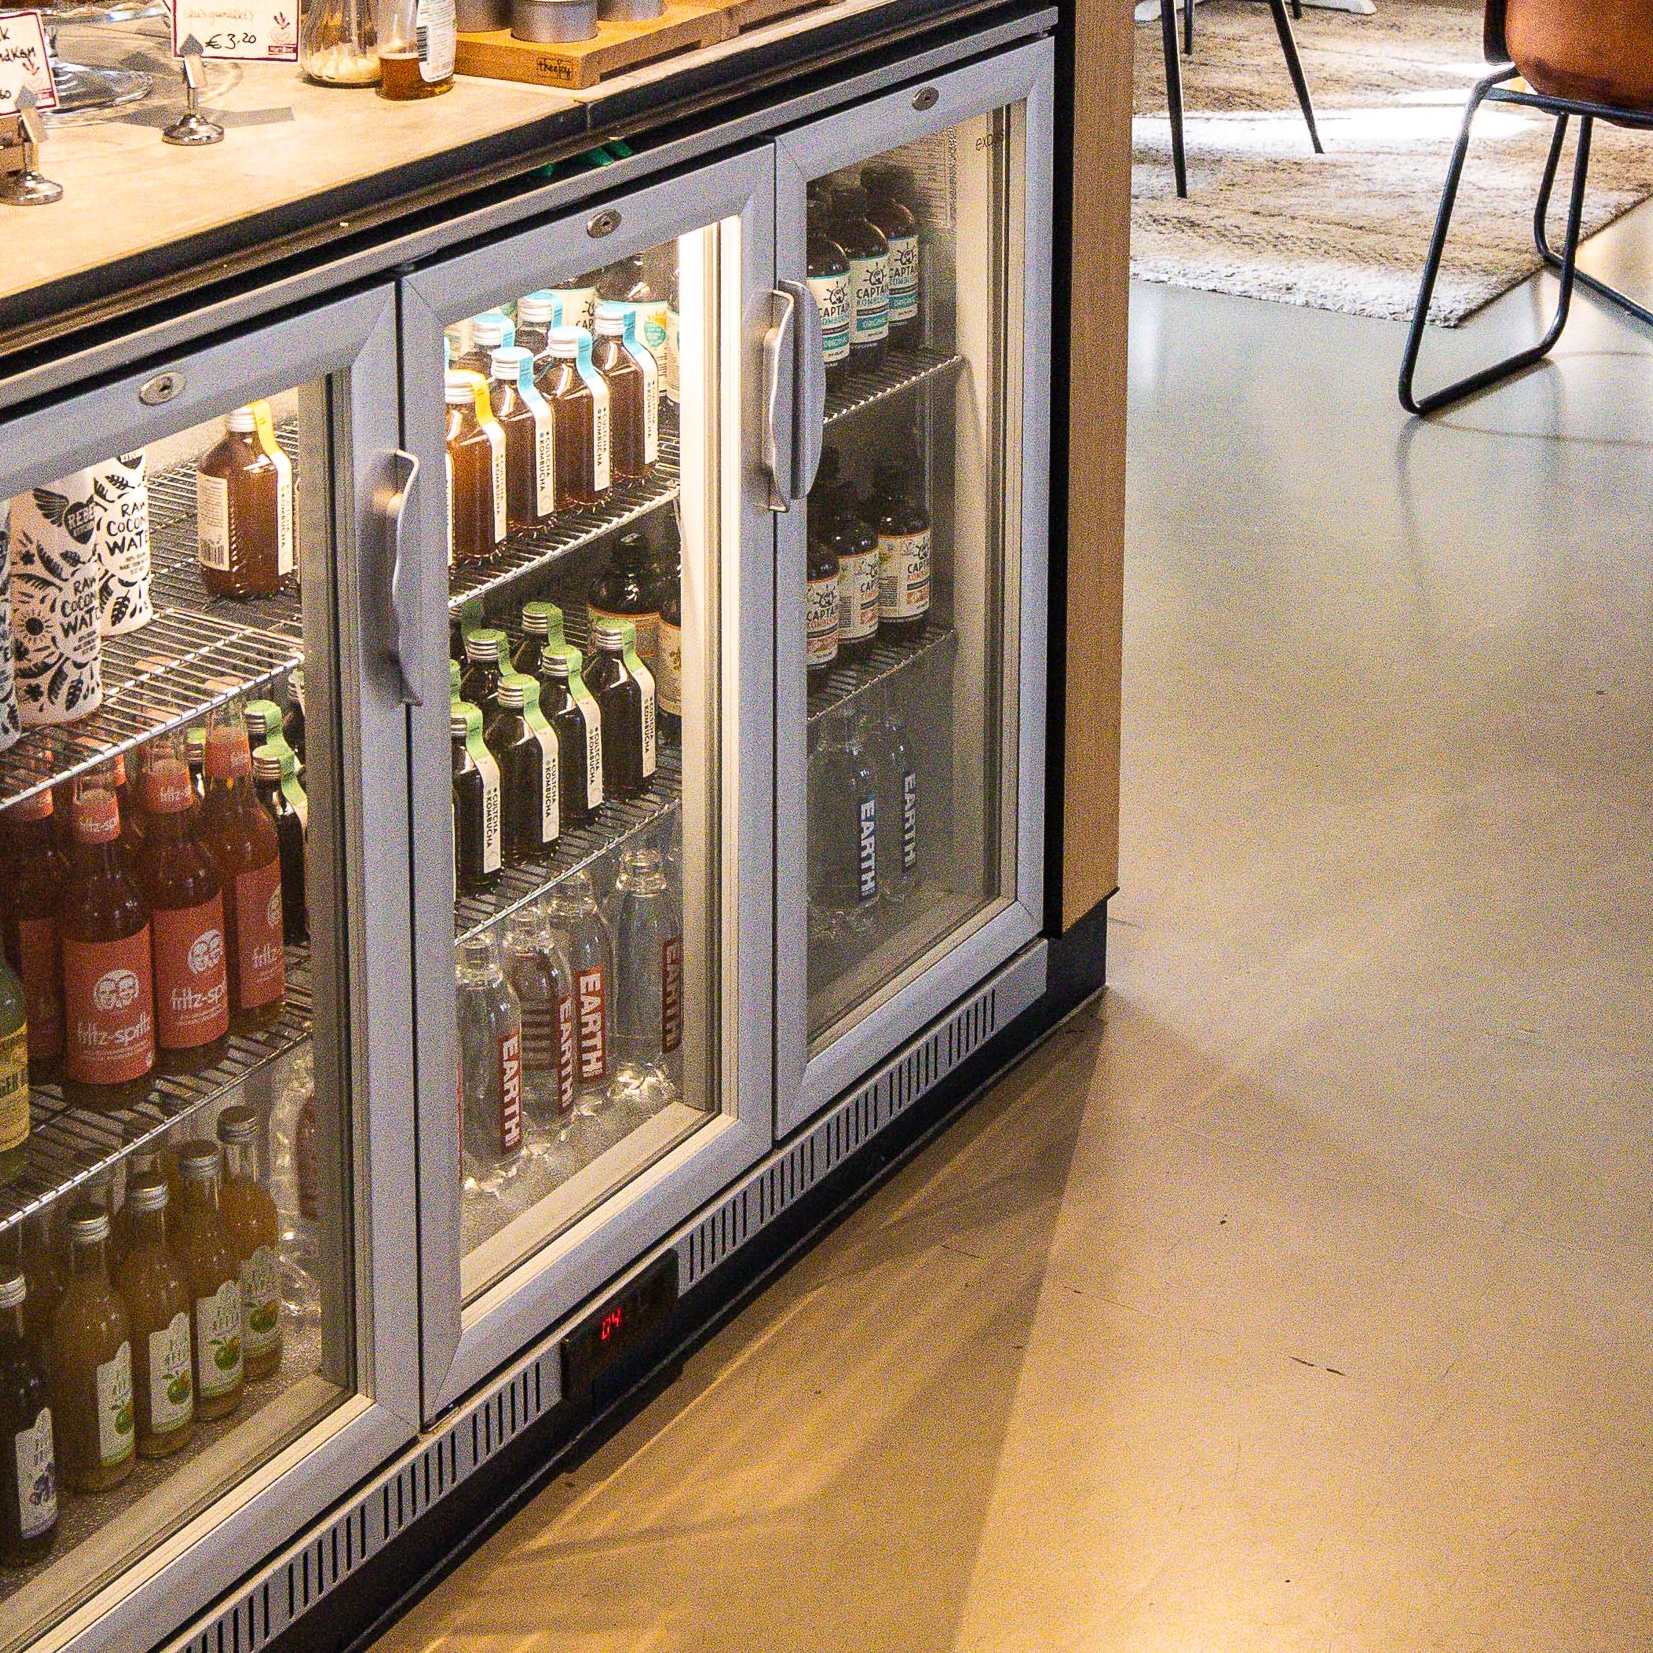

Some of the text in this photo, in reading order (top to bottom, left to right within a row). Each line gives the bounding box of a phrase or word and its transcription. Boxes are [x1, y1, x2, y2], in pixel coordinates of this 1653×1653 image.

[106, 530, 148, 555] WAT
[860, 799, 875, 893] EARTH
[559, 999, 573, 1108] EARTH
[580, 972, 602, 1078] EARTH
[501, 1034, 520, 1147] EARTH
